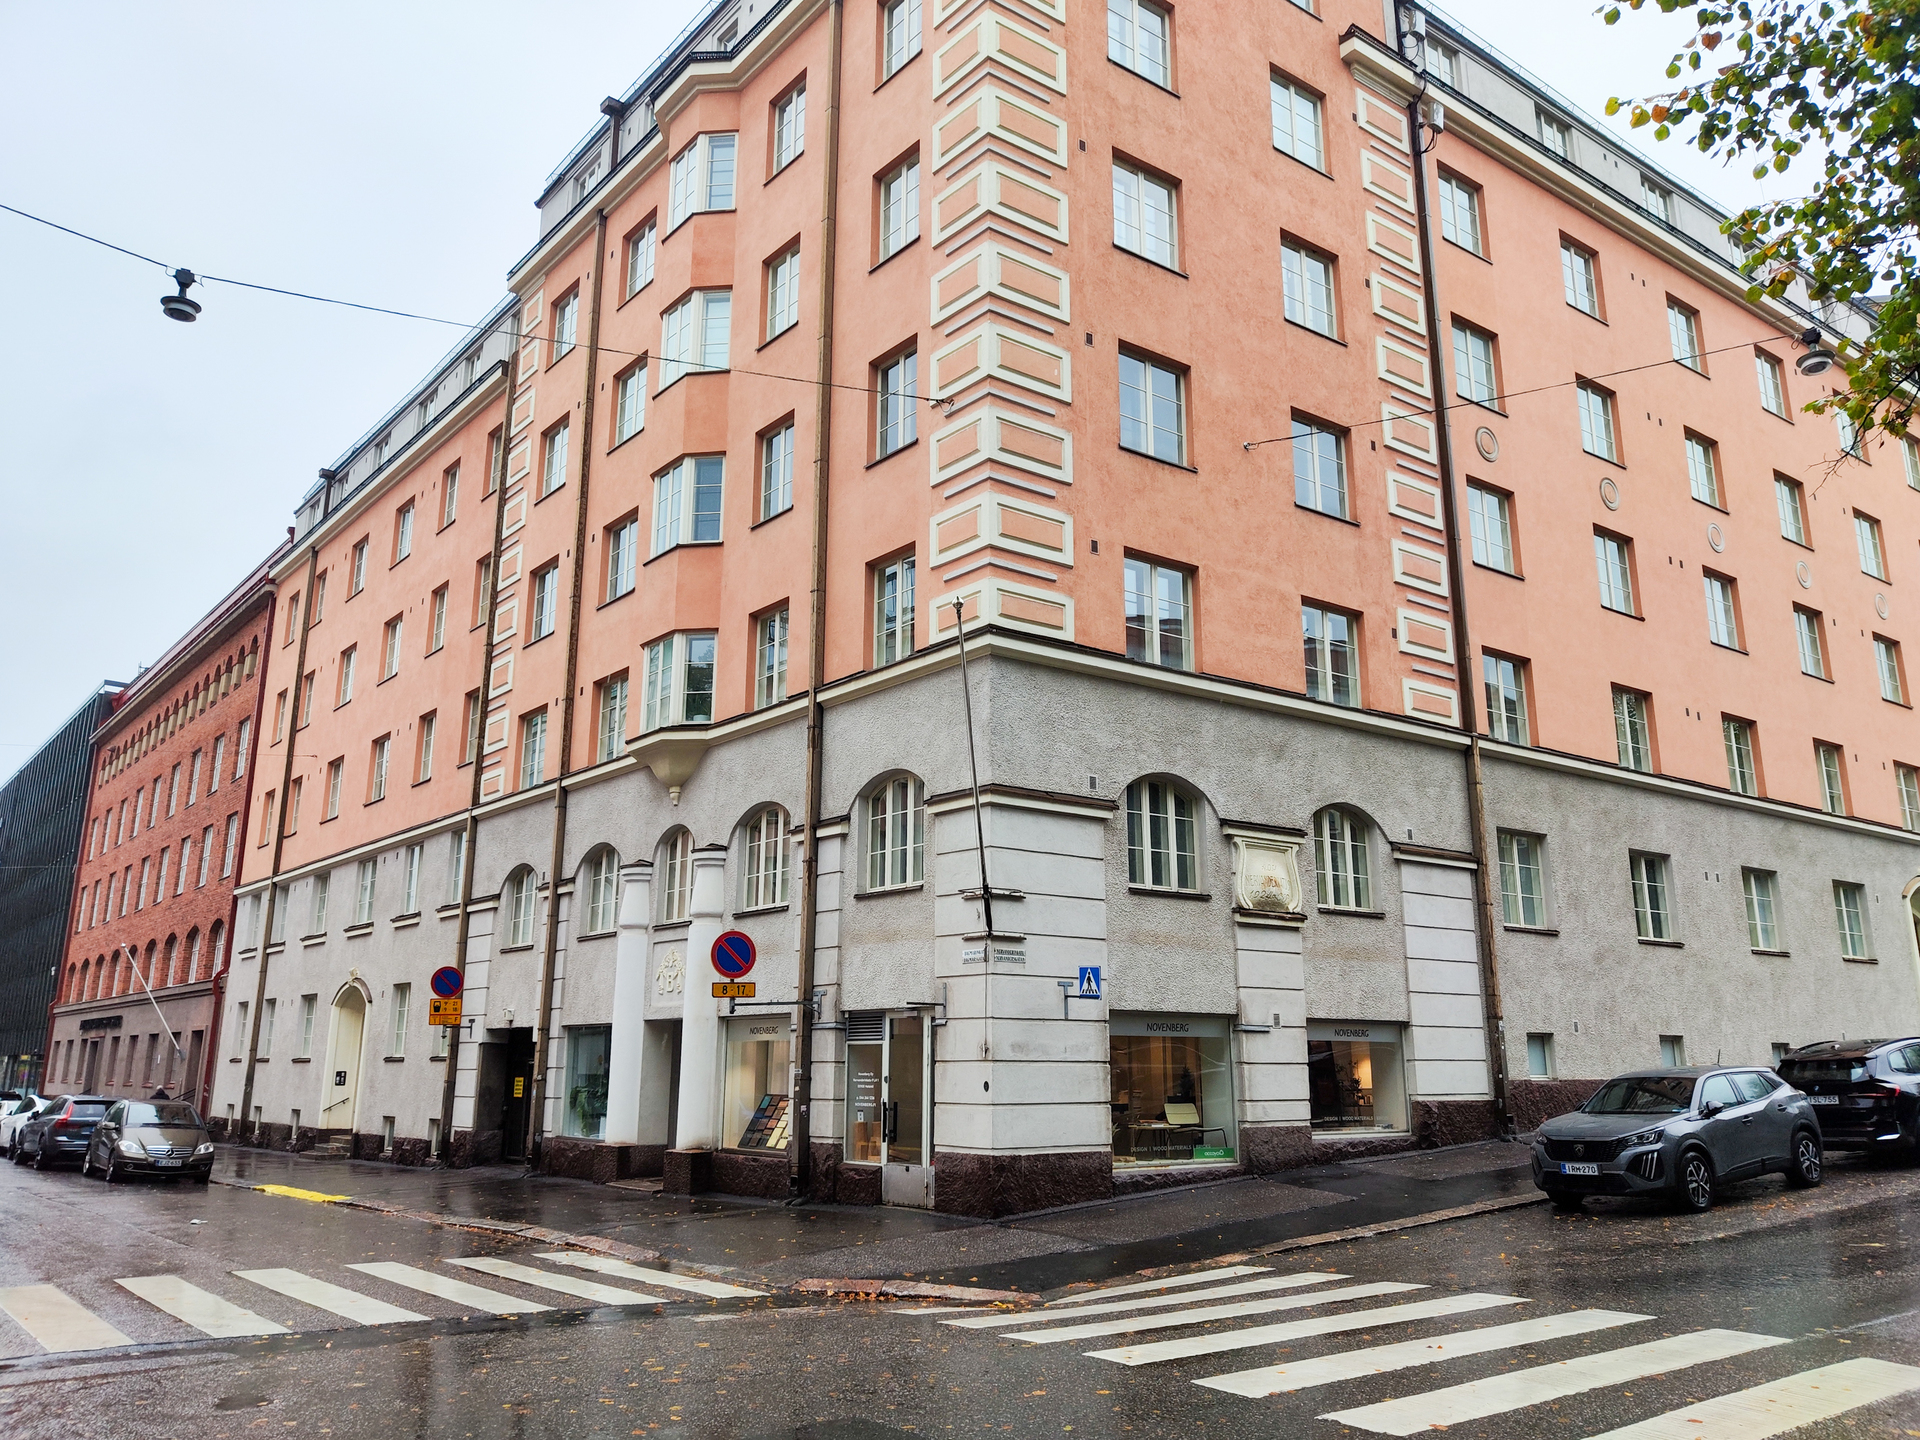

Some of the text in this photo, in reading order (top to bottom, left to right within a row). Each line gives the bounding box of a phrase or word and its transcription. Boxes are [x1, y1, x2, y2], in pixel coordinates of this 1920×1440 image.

[722, 985, 728, 995] 8
[737, 985, 746, 995] 17
[749, 1026, 779, 1035] NOVENBERG
[1147, 1023, 1189, 1032] NOVENBERG
[1334, 1029, 1369, 1037] NOVENBERG
[1567, 1165, 1596, 1173] IRM-270
